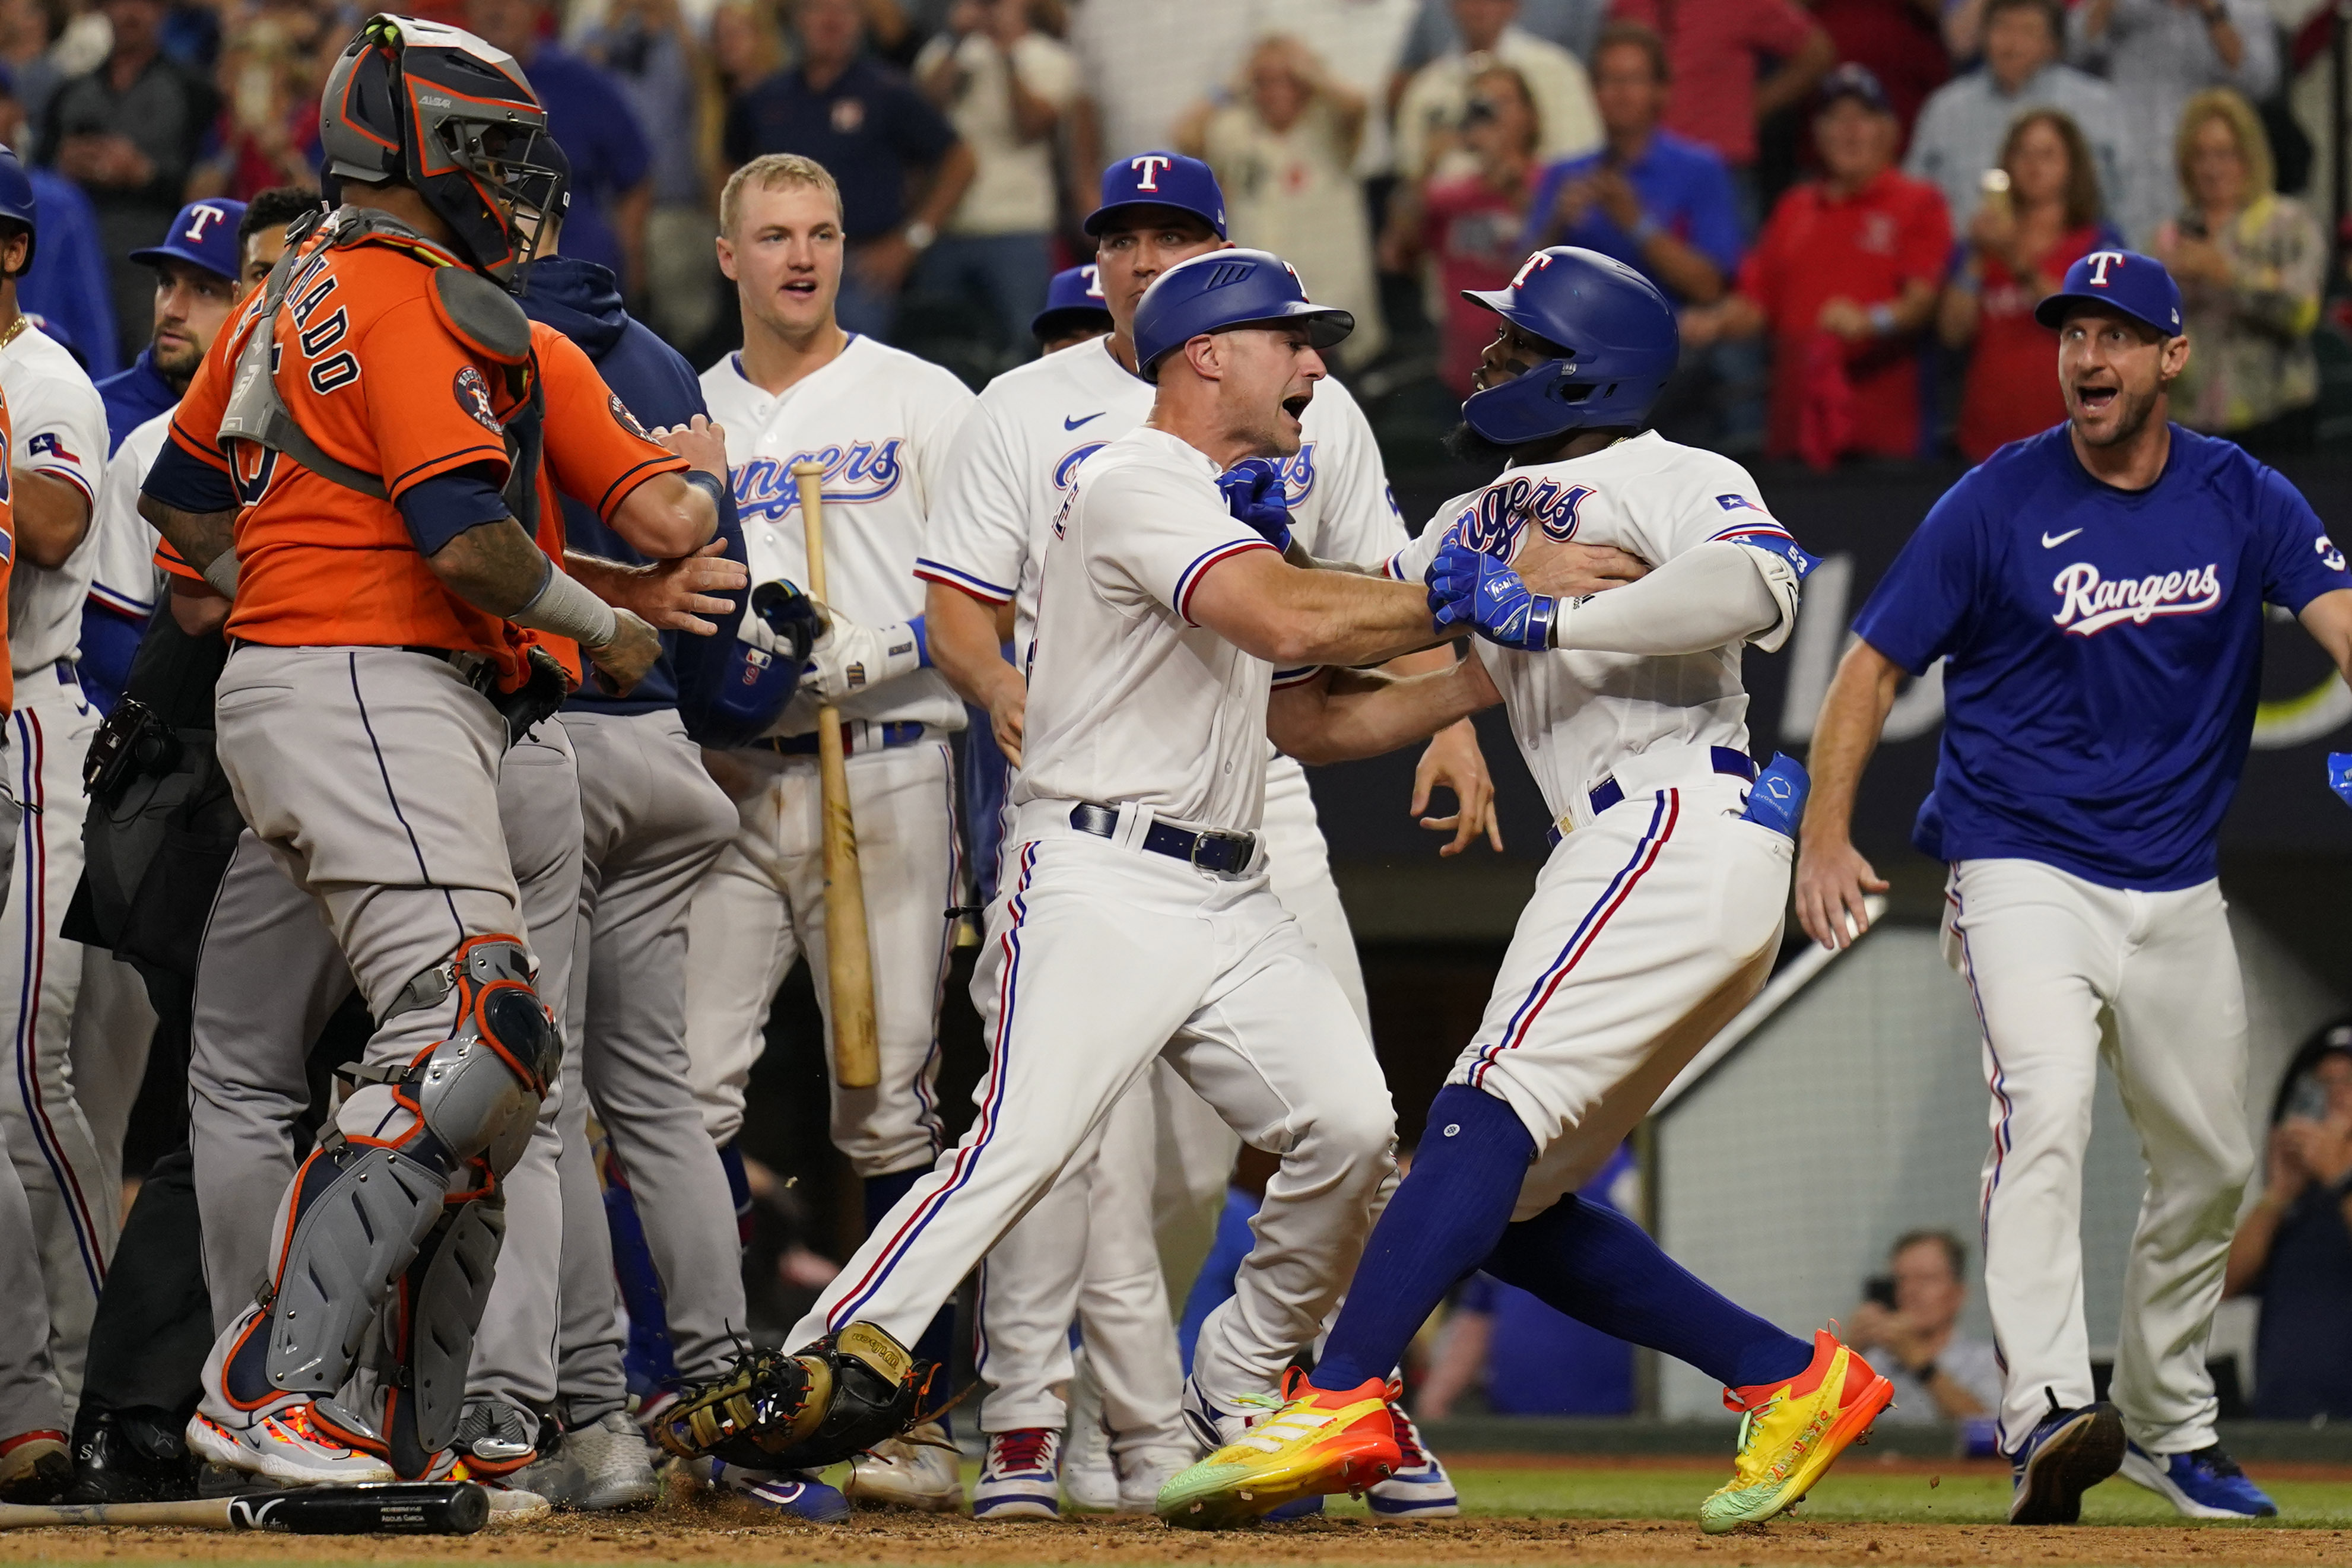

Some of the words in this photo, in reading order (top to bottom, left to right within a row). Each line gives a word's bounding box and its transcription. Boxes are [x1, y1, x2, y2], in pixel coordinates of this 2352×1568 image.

[1131, 156, 1172, 193] T
[186, 205, 225, 243] T
[1512, 251, 1553, 290] T
[2087, 252, 2125, 288] T
[726, 438, 905, 523] ngers
[1441, 476, 1598, 566] ngers
[1788, 545, 1808, 574] 53
[2053, 562, 2220, 637] Rangers
[742, 665, 760, 685] 9
[852, 1333, 900, 1370] Wilson
